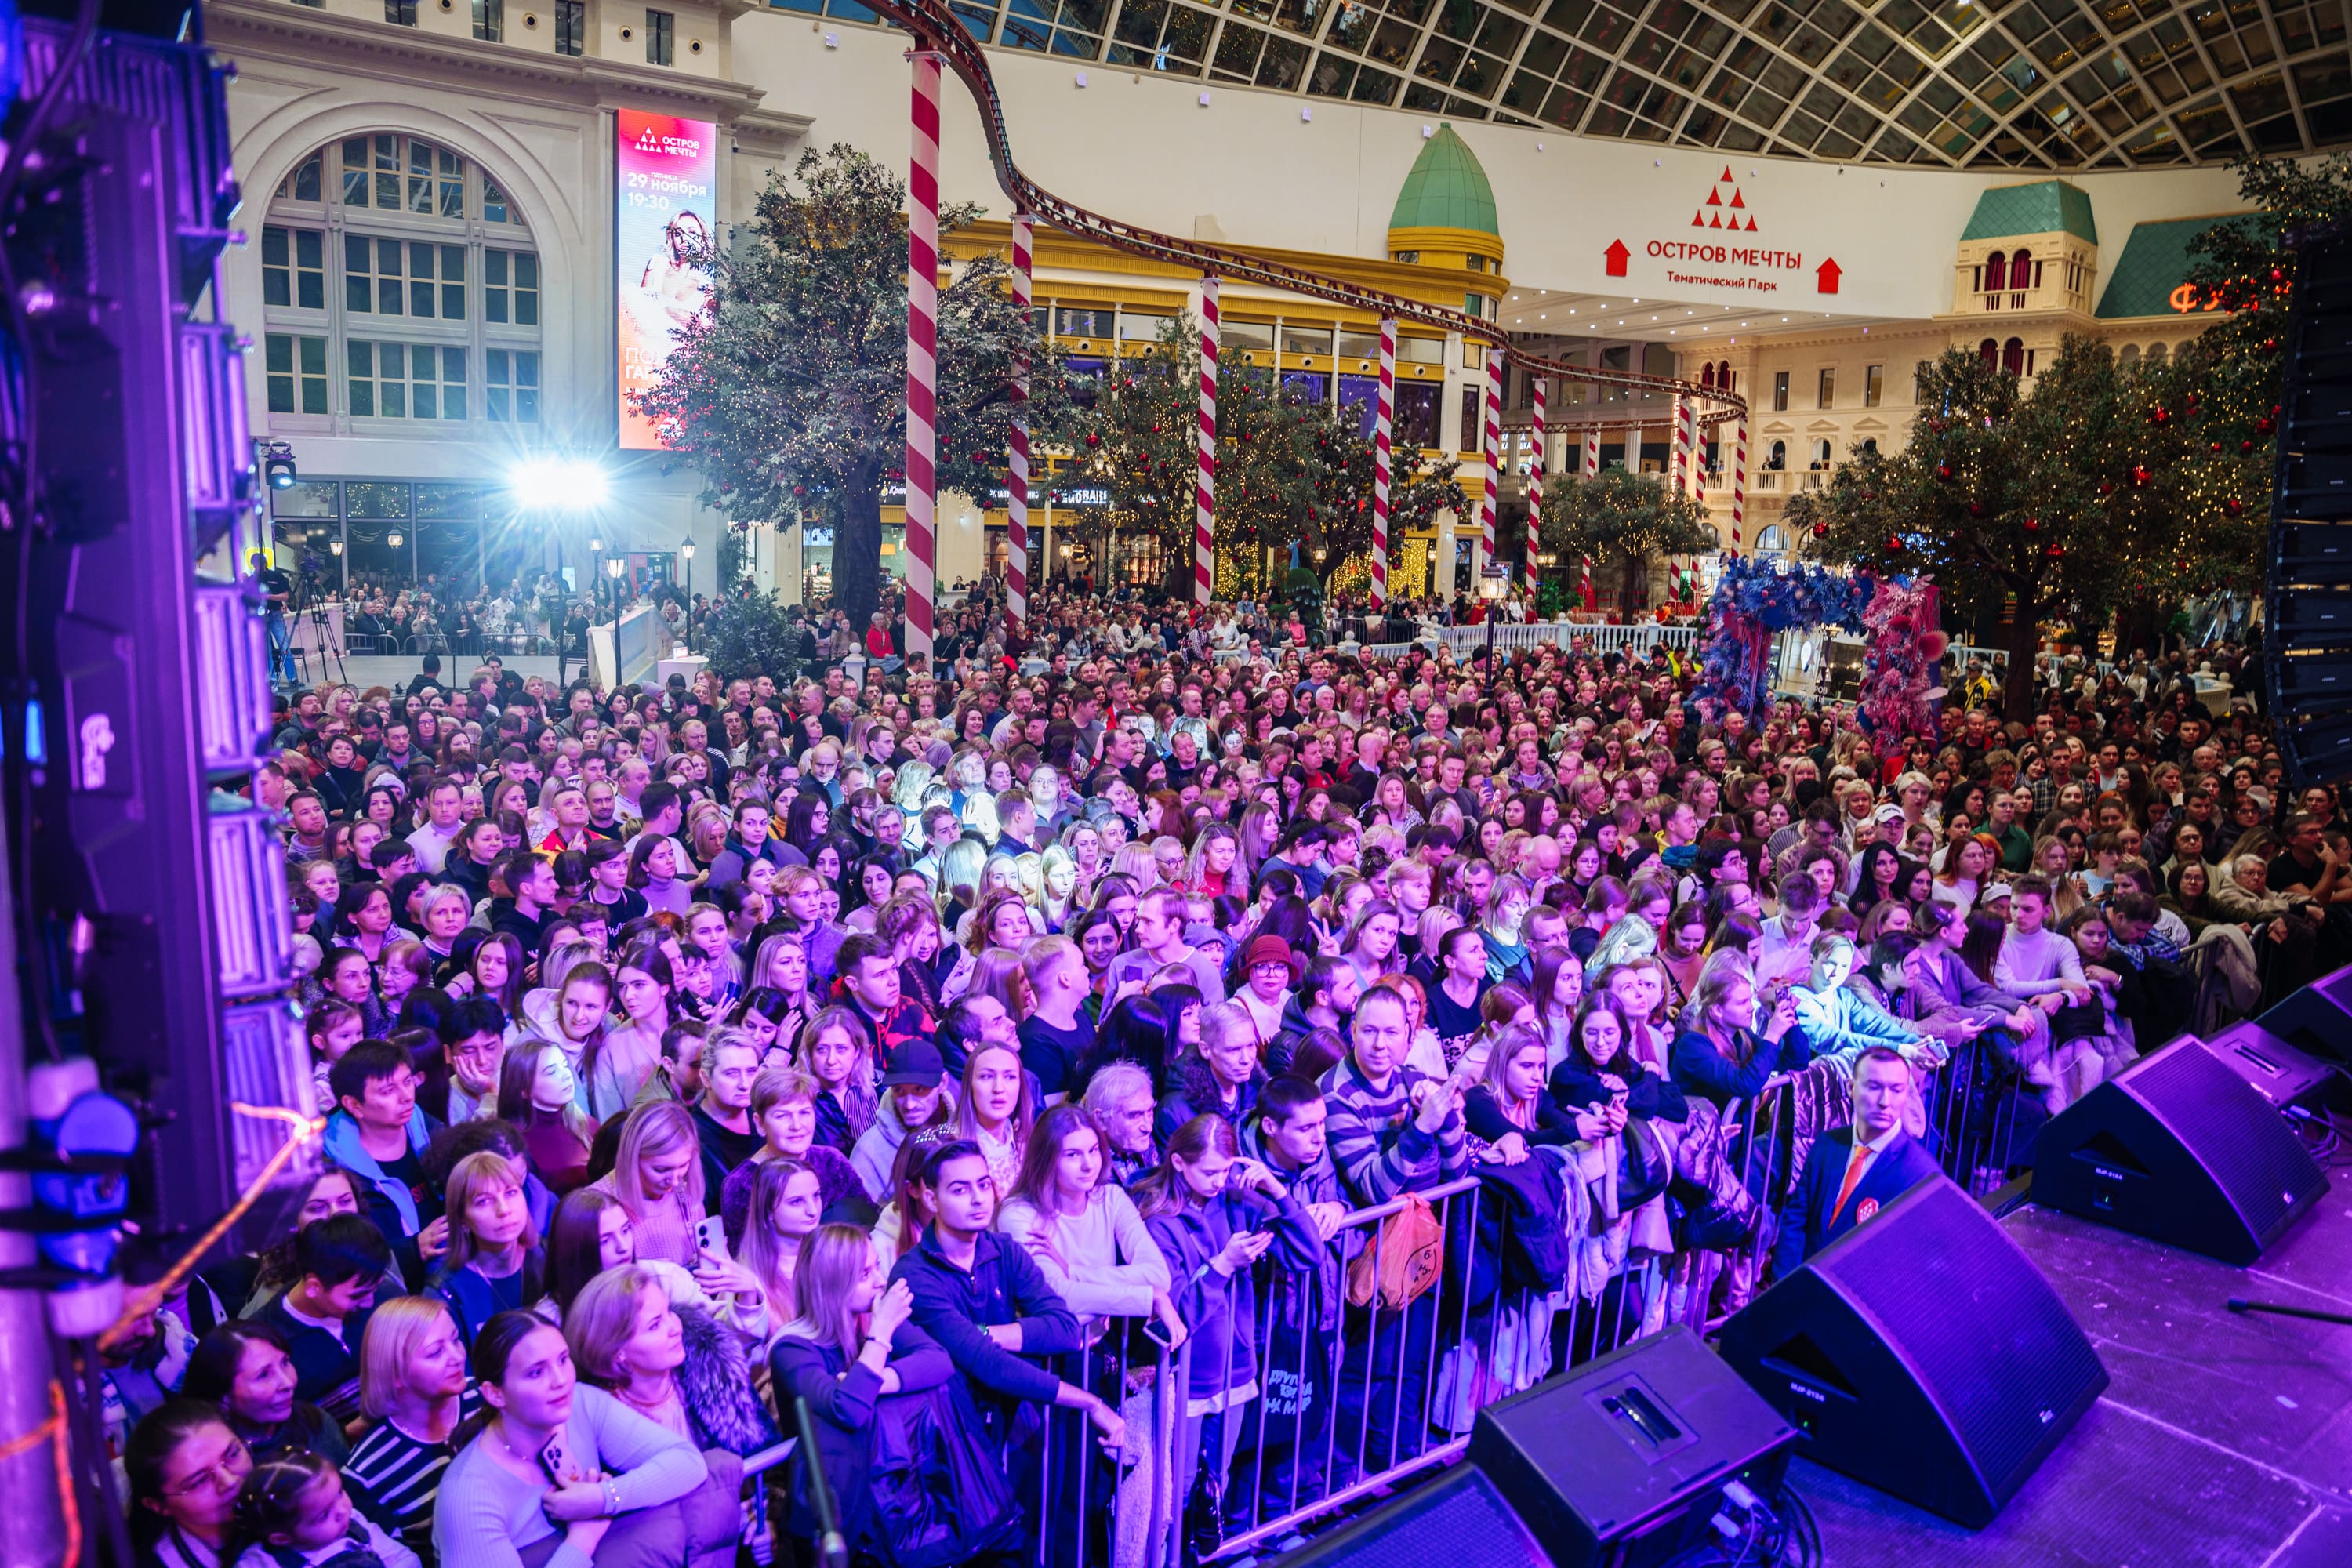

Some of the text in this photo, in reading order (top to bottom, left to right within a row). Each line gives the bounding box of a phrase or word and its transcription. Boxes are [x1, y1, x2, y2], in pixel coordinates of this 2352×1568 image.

[662, 136, 700, 149] ОСТРОВ
[664, 145, 697, 158] МЕЧТЫ
[627, 172, 707, 198] 29 ноября
[627, 192, 670, 210] 19:30
[1646, 240, 1802, 270] ОСТРОВ МЕЧТЫ
[1667, 271, 1777, 293] Тематический Парк
